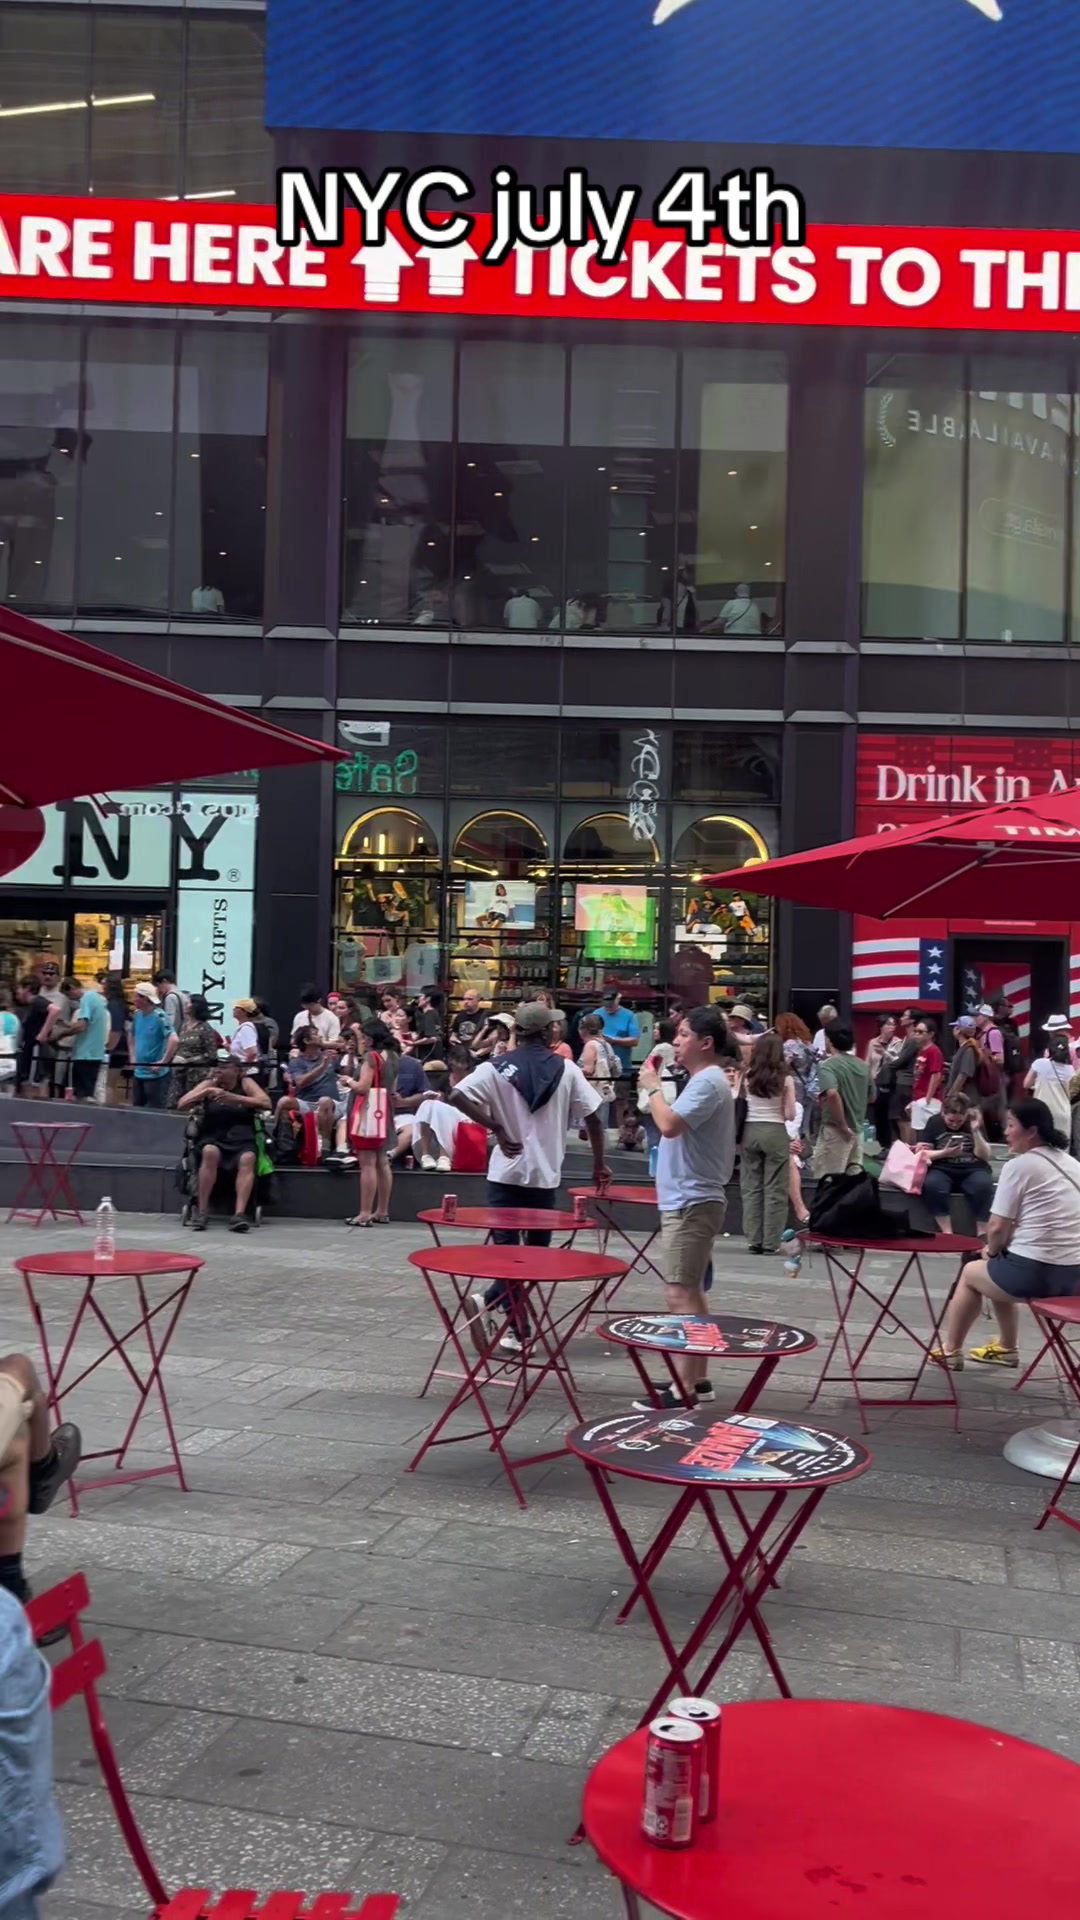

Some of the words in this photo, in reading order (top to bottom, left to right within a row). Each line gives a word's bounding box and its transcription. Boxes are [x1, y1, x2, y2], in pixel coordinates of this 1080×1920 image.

[133, 220, 328, 288] HERE
[511, 239, 818, 304] TICKETS
[836, 245, 942, 308] TO
[876, 764, 988, 804] Drink
[994, 766, 1031, 804] in
[52, 799, 227, 882] NY
[211, 898, 229, 967] GIFTS
